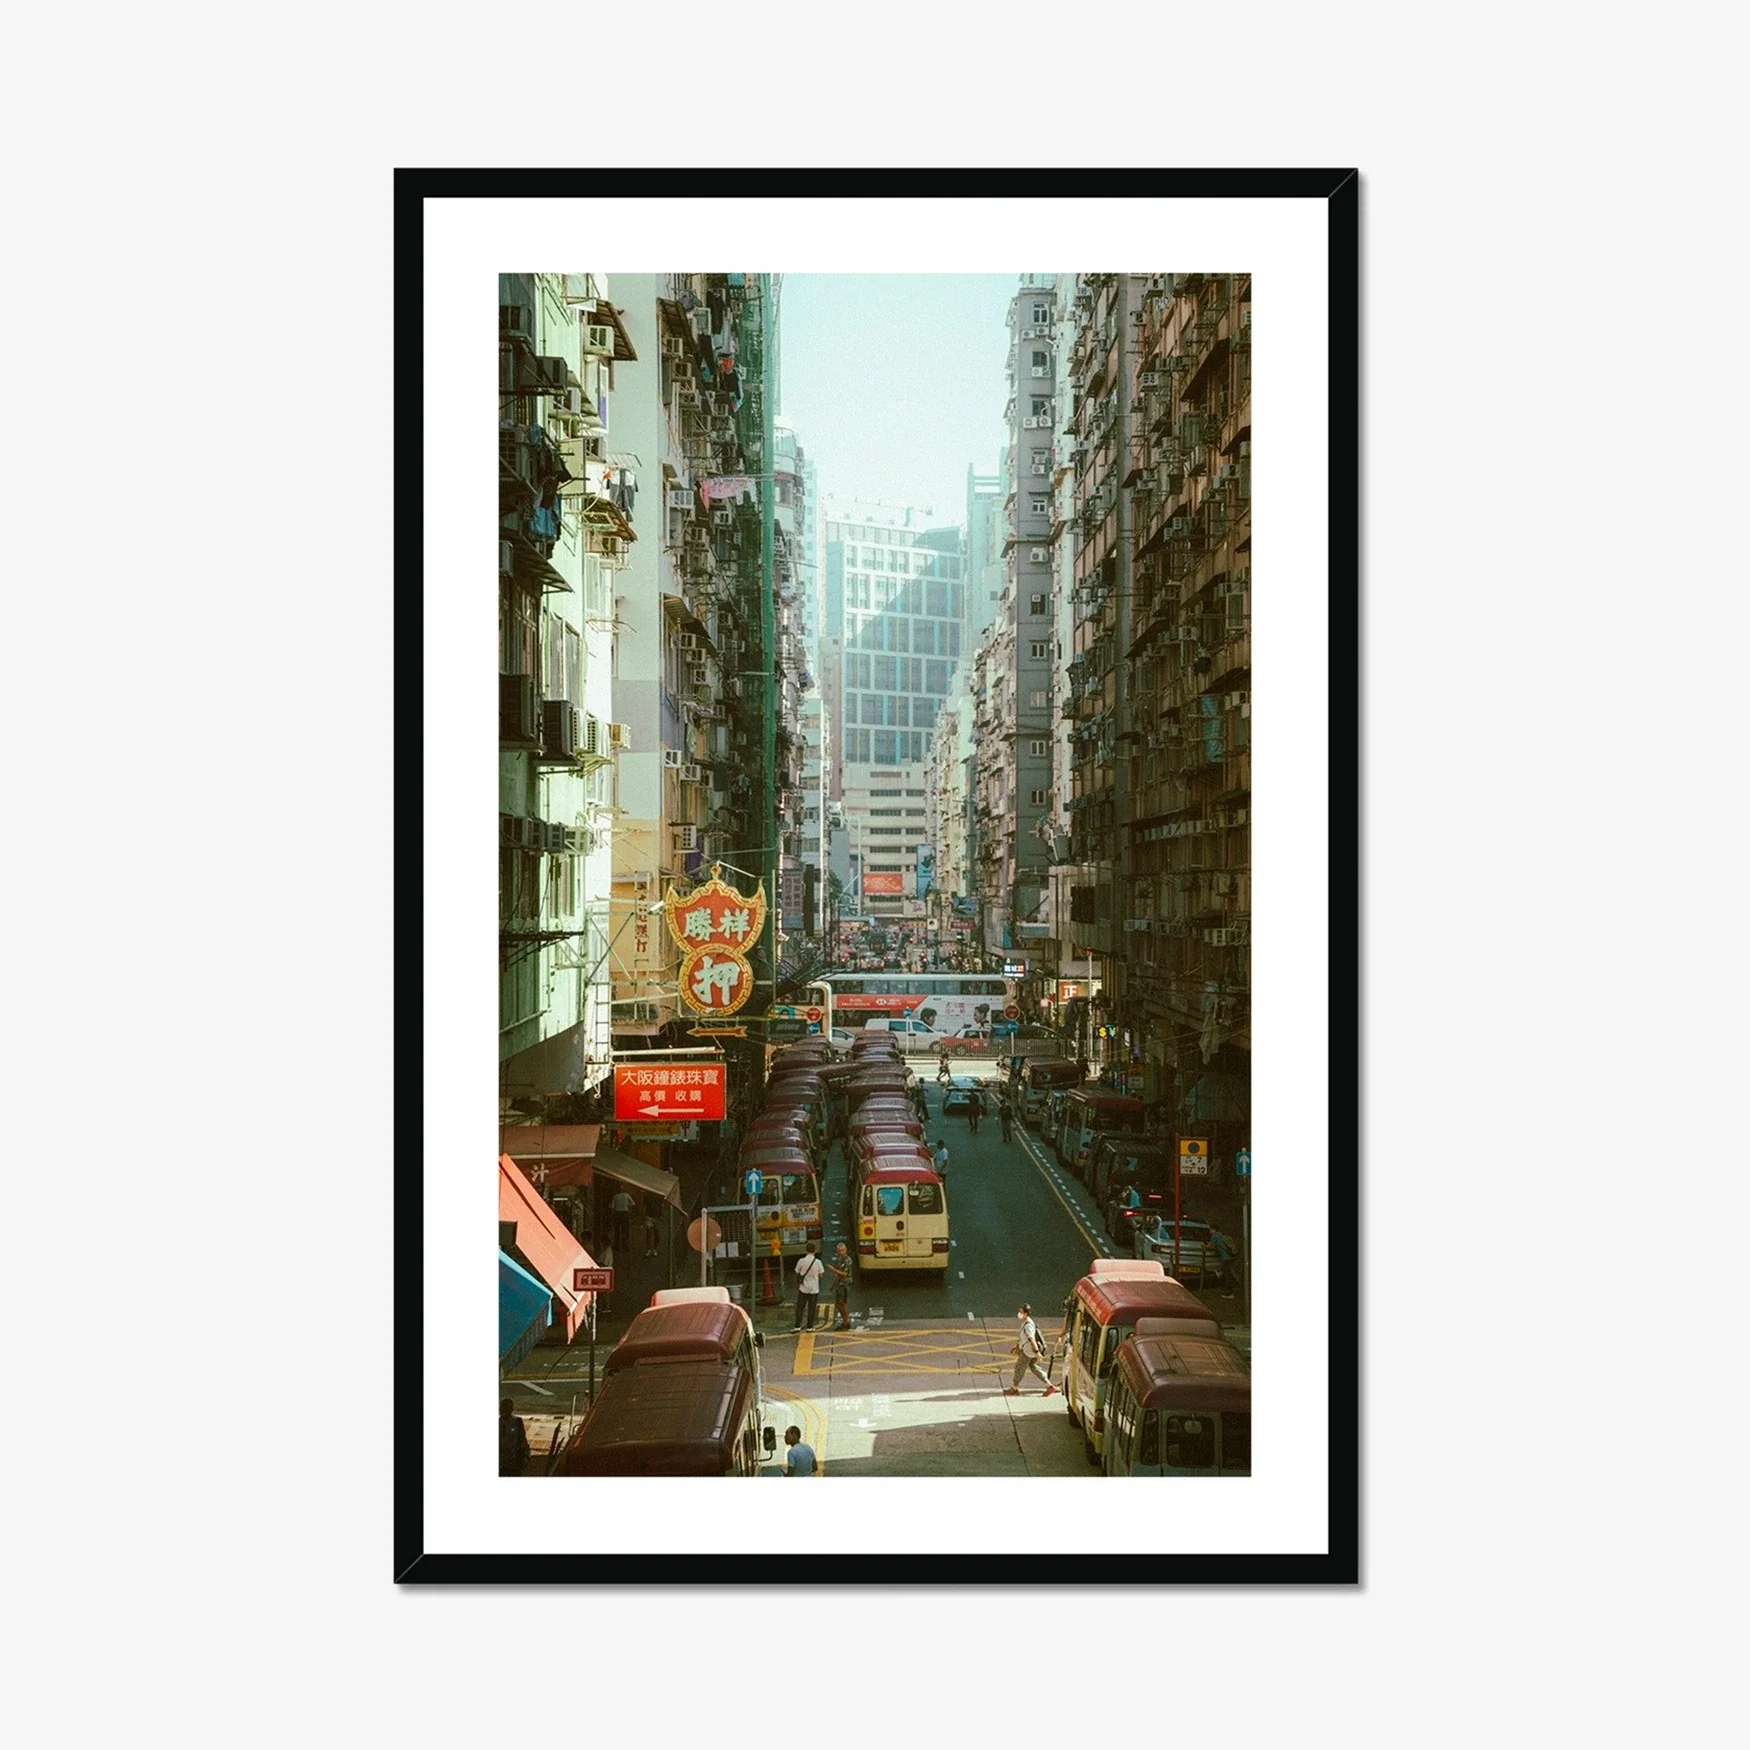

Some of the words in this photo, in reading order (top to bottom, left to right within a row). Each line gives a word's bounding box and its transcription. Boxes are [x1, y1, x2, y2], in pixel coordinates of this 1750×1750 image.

[691, 955, 741, 1006] 押
[621, 1069, 719, 1086] 大阪鐘錶珠寶
